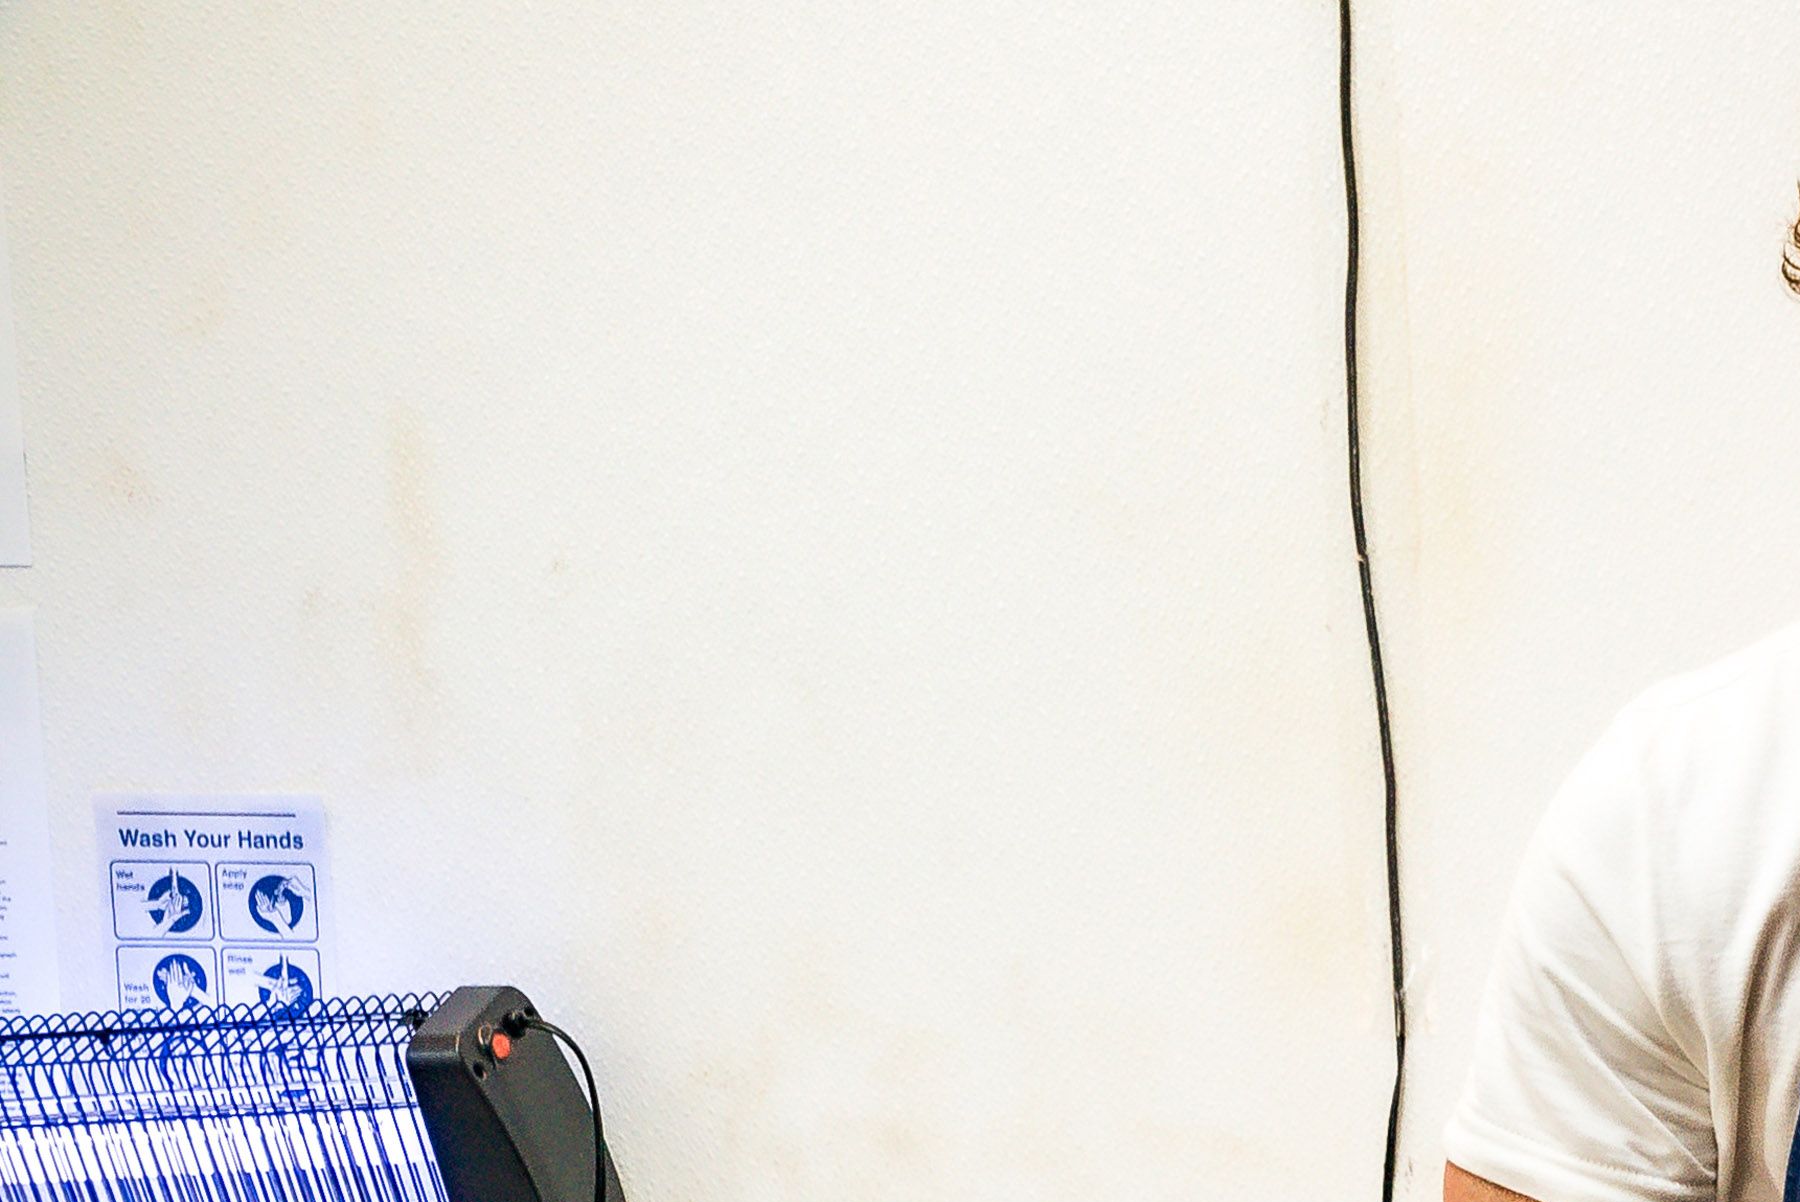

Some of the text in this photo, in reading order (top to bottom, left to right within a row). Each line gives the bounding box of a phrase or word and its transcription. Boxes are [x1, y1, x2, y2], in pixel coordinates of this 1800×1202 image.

[118, 828, 304, 850] Wash Your Hands
[115, 870, 134, 880] Wet
[222, 868, 248, 880] Apply
[116, 882, 146, 892] hands
[123, 982, 150, 993] Wash
